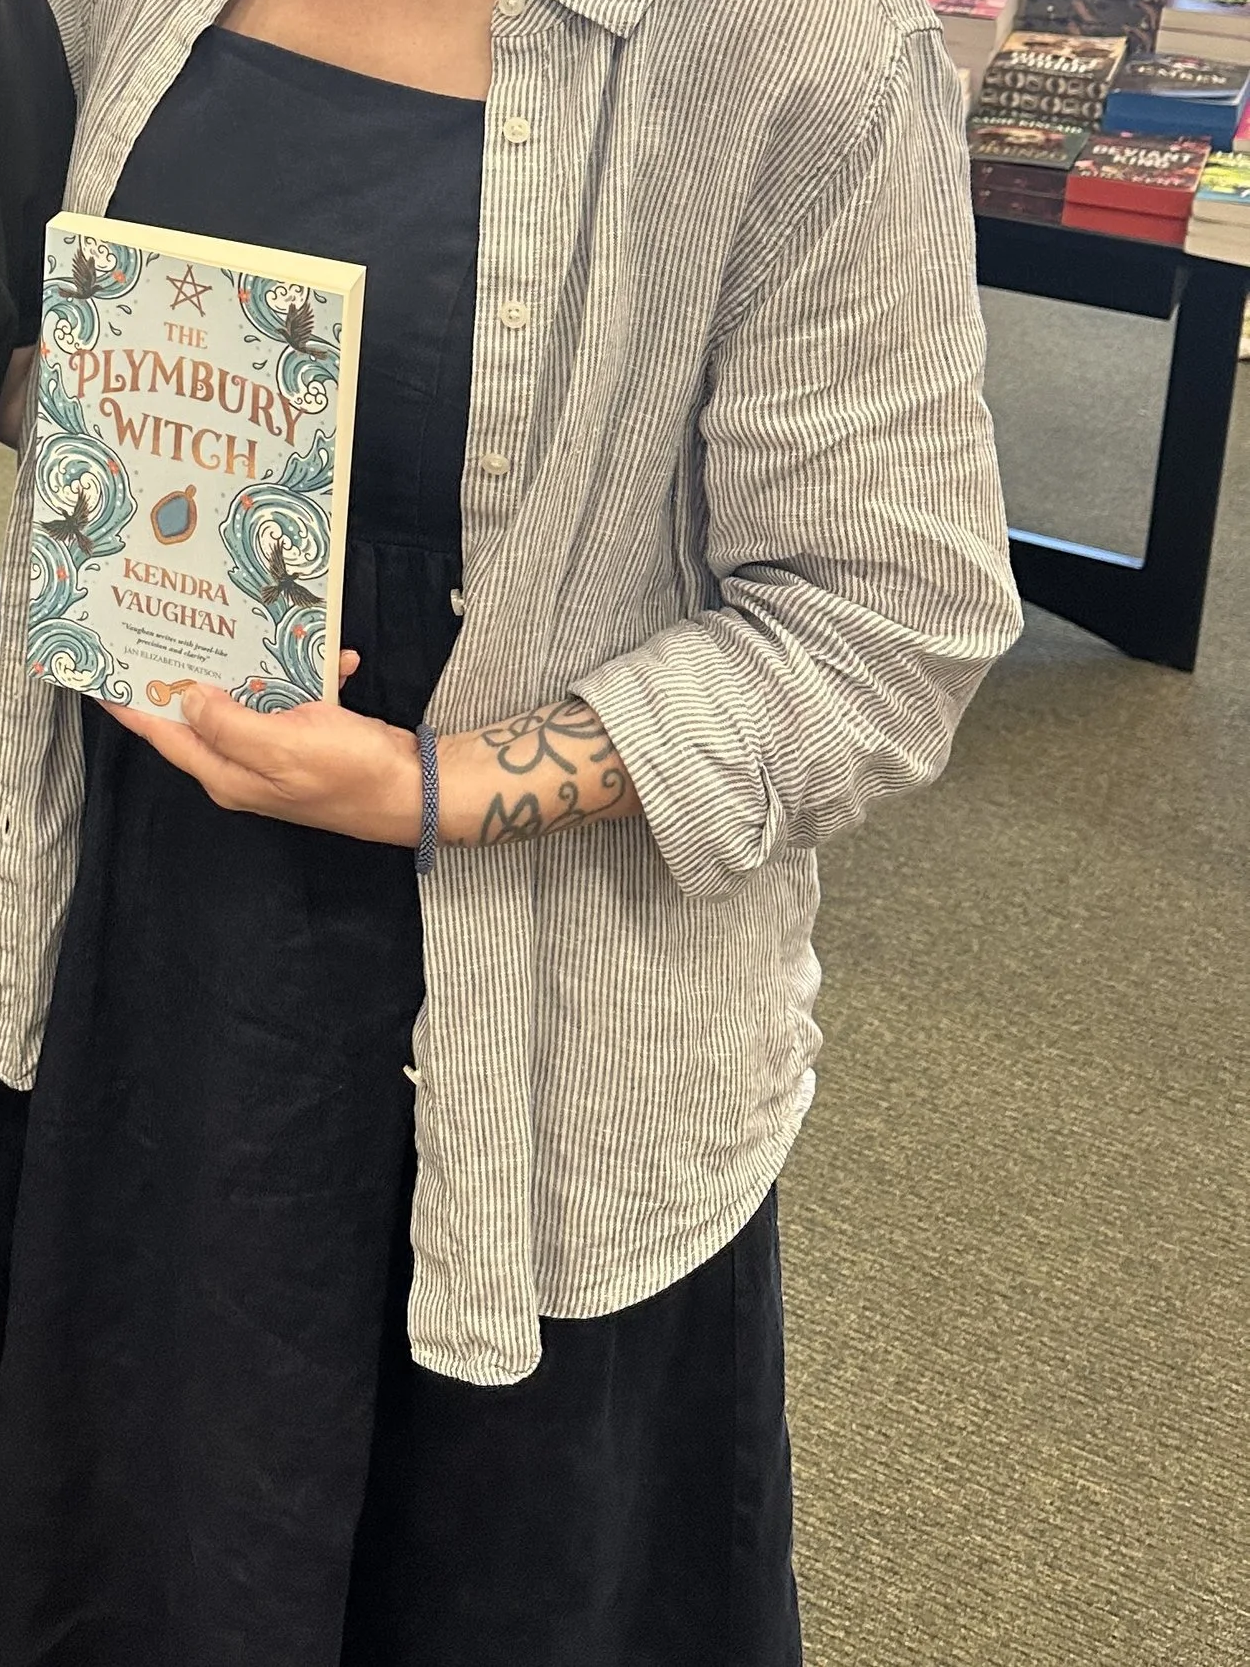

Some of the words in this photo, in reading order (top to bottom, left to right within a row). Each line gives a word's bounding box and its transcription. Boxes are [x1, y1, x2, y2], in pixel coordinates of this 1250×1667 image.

[1092, 144, 1192, 163] DEVIANT
[1113, 153, 1171, 169] KING
[164, 321, 208, 349] THE
[68, 348, 307, 447] PLYMBURY
[99, 397, 258, 479] WITCH
[123, 557, 229, 606] KENDRA
[111, 585, 237, 639] VAUGHAN
[136, 637, 167, 650] precision
[167, 645, 183, 655] and
[156, 633, 176, 643] writes
[178, 637, 194, 647] with
[193, 643, 228, 657] jewel-like
[124, 646, 139, 655] JAN
[140, 650, 185, 669] ELIZABETH
[186, 663, 222, 680] WATSON
